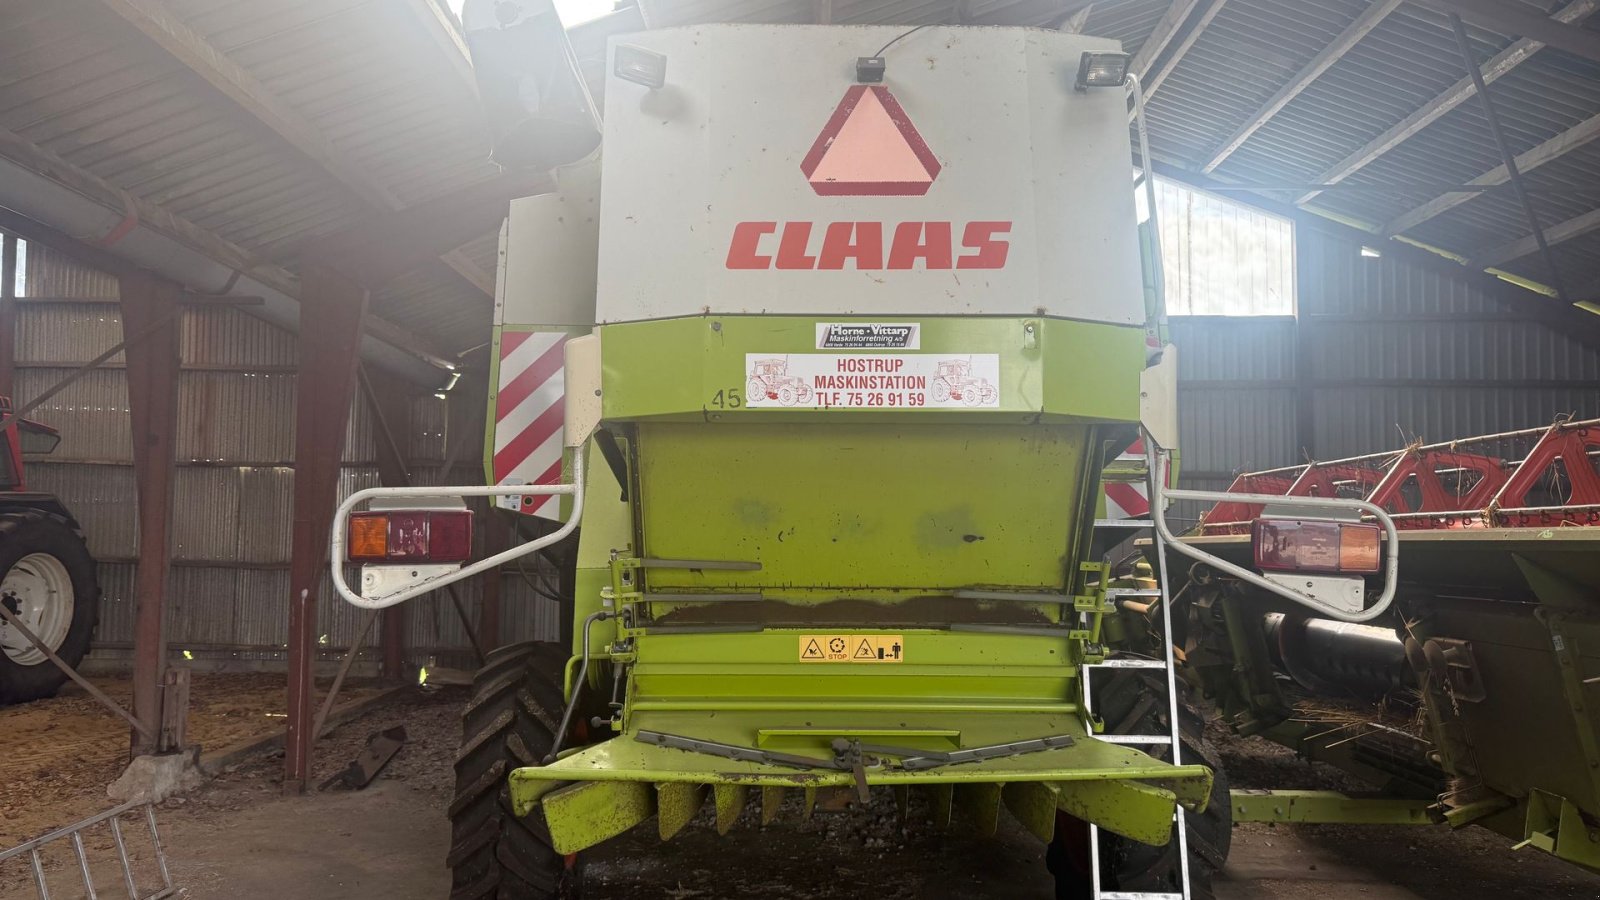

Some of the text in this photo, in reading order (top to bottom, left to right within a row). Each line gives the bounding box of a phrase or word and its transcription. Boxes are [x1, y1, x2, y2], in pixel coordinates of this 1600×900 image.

[726, 221, 1012, 270] CLAAS
[830, 324, 908, 337] Horne Vittarp
[829, 335, 893, 343] Maskinforretning
[837, 358, 903, 373] HOSTRUP
[815, 375, 926, 390] MASKINSTATION
[712, 388, 741, 408] 45
[815, 392, 925, 406] TLF. 75 26 91 59
